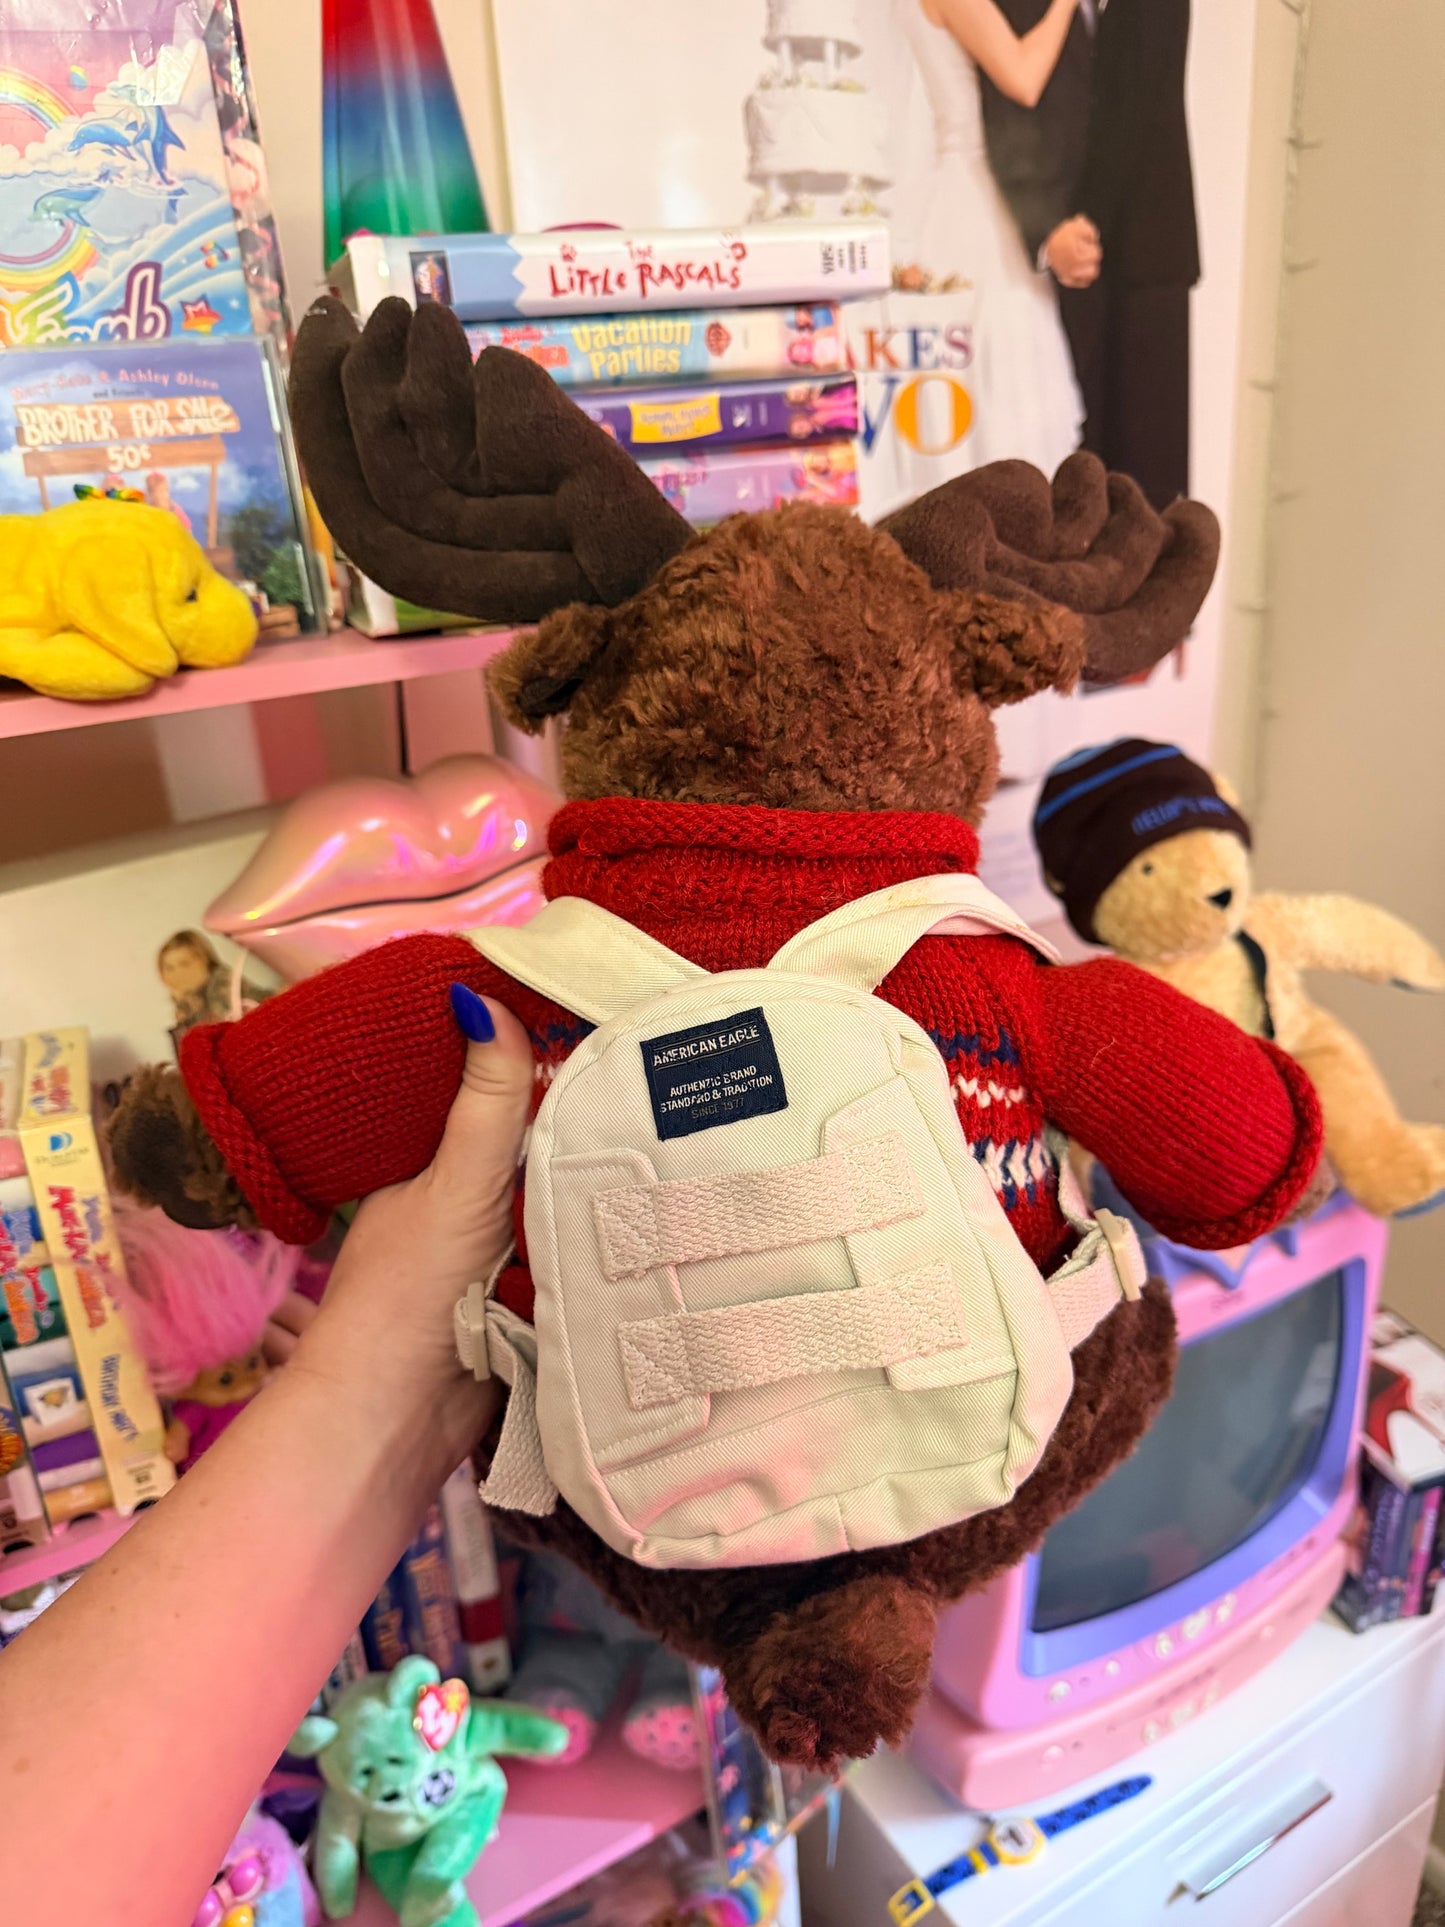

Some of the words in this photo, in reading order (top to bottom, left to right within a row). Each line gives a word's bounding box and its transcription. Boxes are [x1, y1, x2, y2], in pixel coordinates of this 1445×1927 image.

[636, 261, 741, 298] RASCALS
[128, 399, 176, 439] FOR
[653, 1037, 718, 1067] AMERICAN
[718, 1025, 760, 1049] EAGLE
[660, 1092, 711, 1113] STANDARD
[712, 1089, 722, 1099] &
[722, 1074, 773, 1097] TRADITION
[670, 1075, 721, 1098] AUTHENTIC
[723, 1065, 757, 1084] BRAND
[691, 1103, 719, 1119] SINCE
